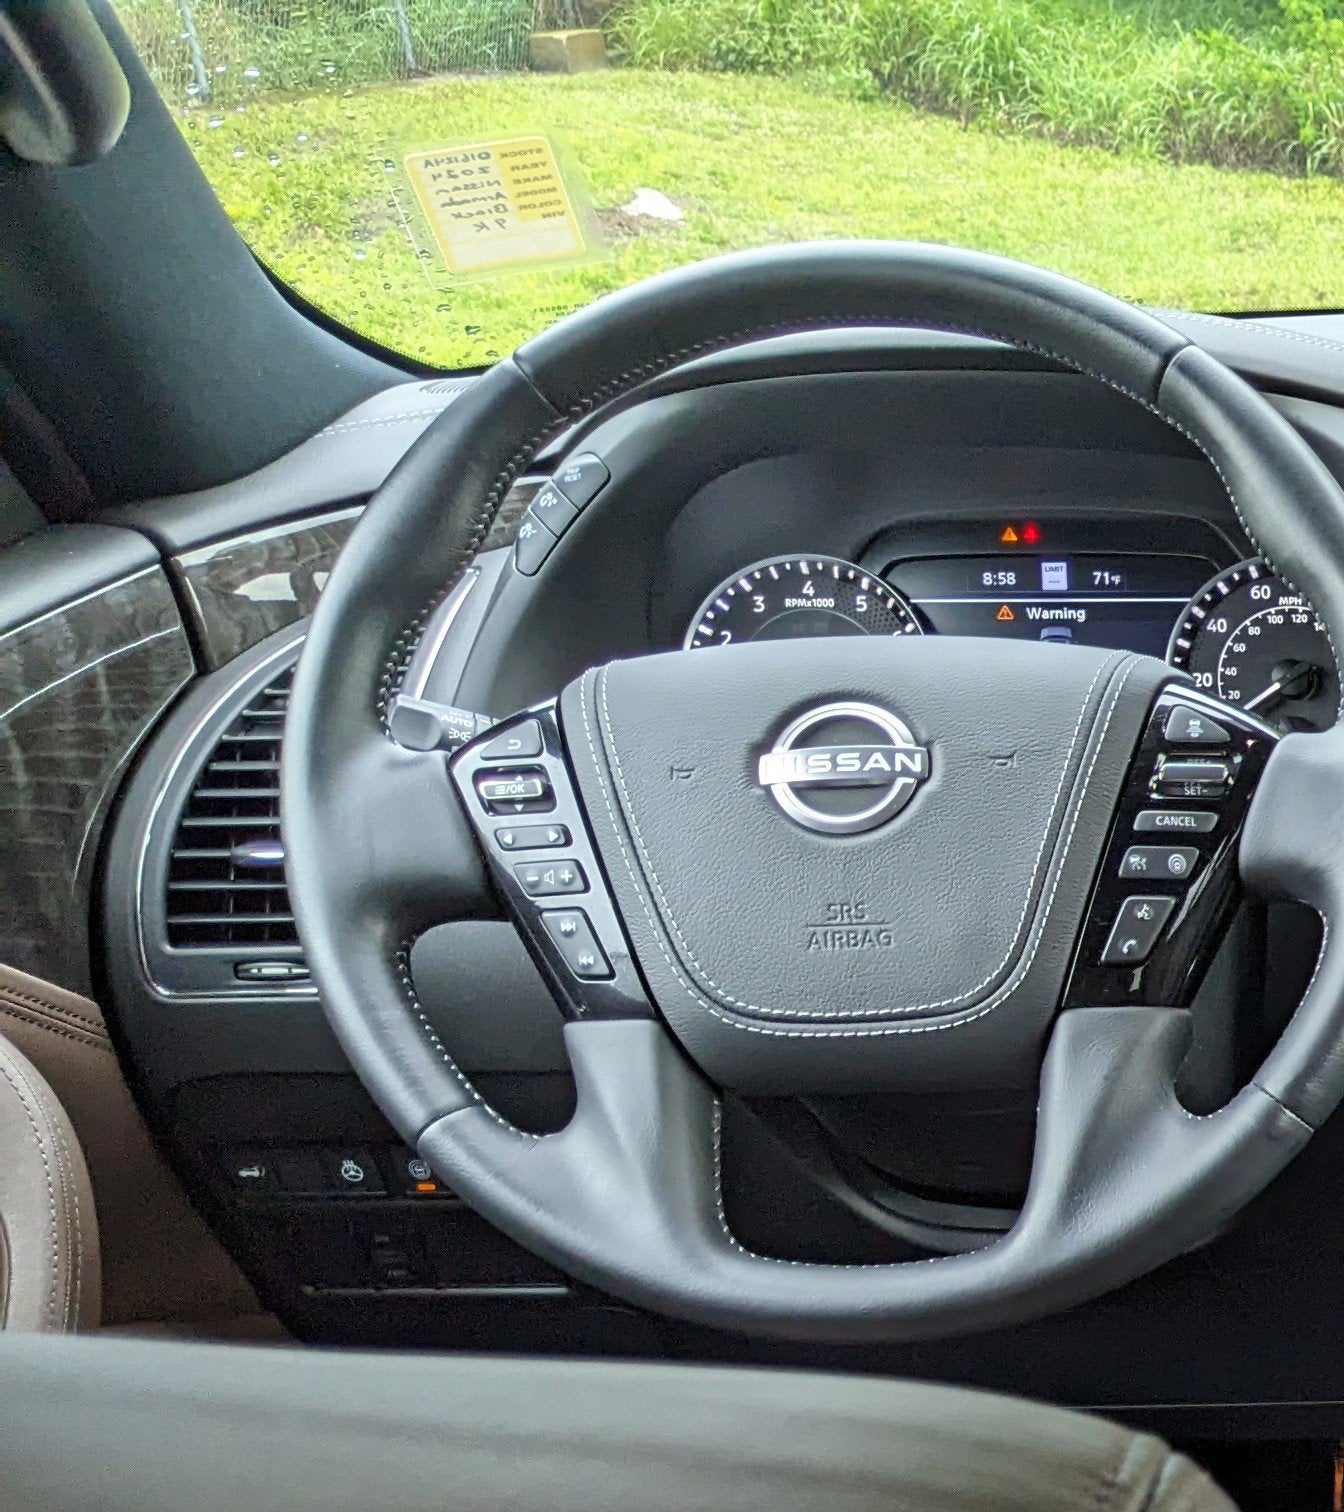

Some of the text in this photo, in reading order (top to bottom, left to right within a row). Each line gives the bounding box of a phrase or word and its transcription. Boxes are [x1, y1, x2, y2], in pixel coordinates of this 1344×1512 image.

[982, 572, 1016, 585] 8:58
[802, 580, 815, 597] 4
[1250, 585, 1271, 600] 60
[753, 596, 765, 612] 3
[856, 596, 867, 612] 5
[1279, 597, 1302, 606] MPH
[1026, 607, 1086, 622] Warning
[1267, 615, 1284, 624] 100
[1291, 614, 1308, 624] 120
[1206, 618, 1227, 633] 40
[1248, 626, 1261, 635] 80
[1233, 642, 1246, 652] 60
[1224, 667, 1237, 676] 40
[1192, 673, 1213, 687] 20
[1228, 690, 1241, 700] 20
[441, 714, 474, 728] AUTO
[1155, 816, 1198, 827] CANCEL
[826, 903, 868, 922] SRS
[807, 930, 893, 951] AIRBAG
